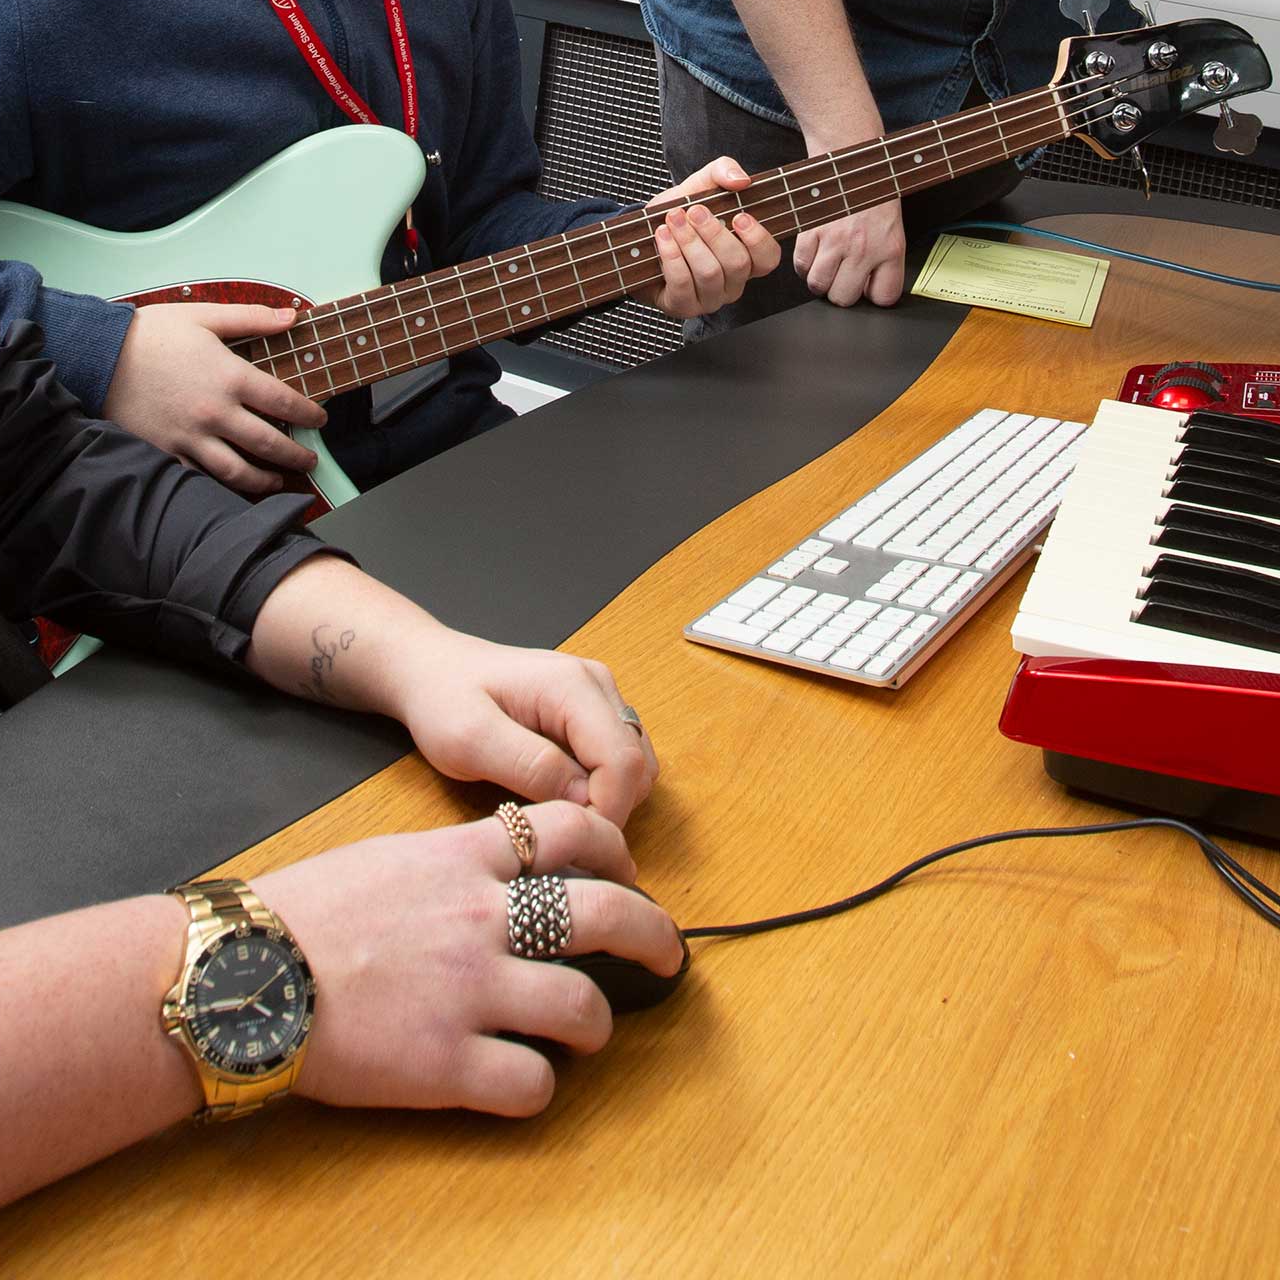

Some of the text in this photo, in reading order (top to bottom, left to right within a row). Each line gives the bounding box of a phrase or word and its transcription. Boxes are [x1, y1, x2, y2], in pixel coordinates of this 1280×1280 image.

[287, 12, 310, 44] Student
[392, 6, 403, 35] College
[306, 42, 319, 57] Arts
[397, 38, 408, 62] Music
[316, 57, 344, 95] Performing
